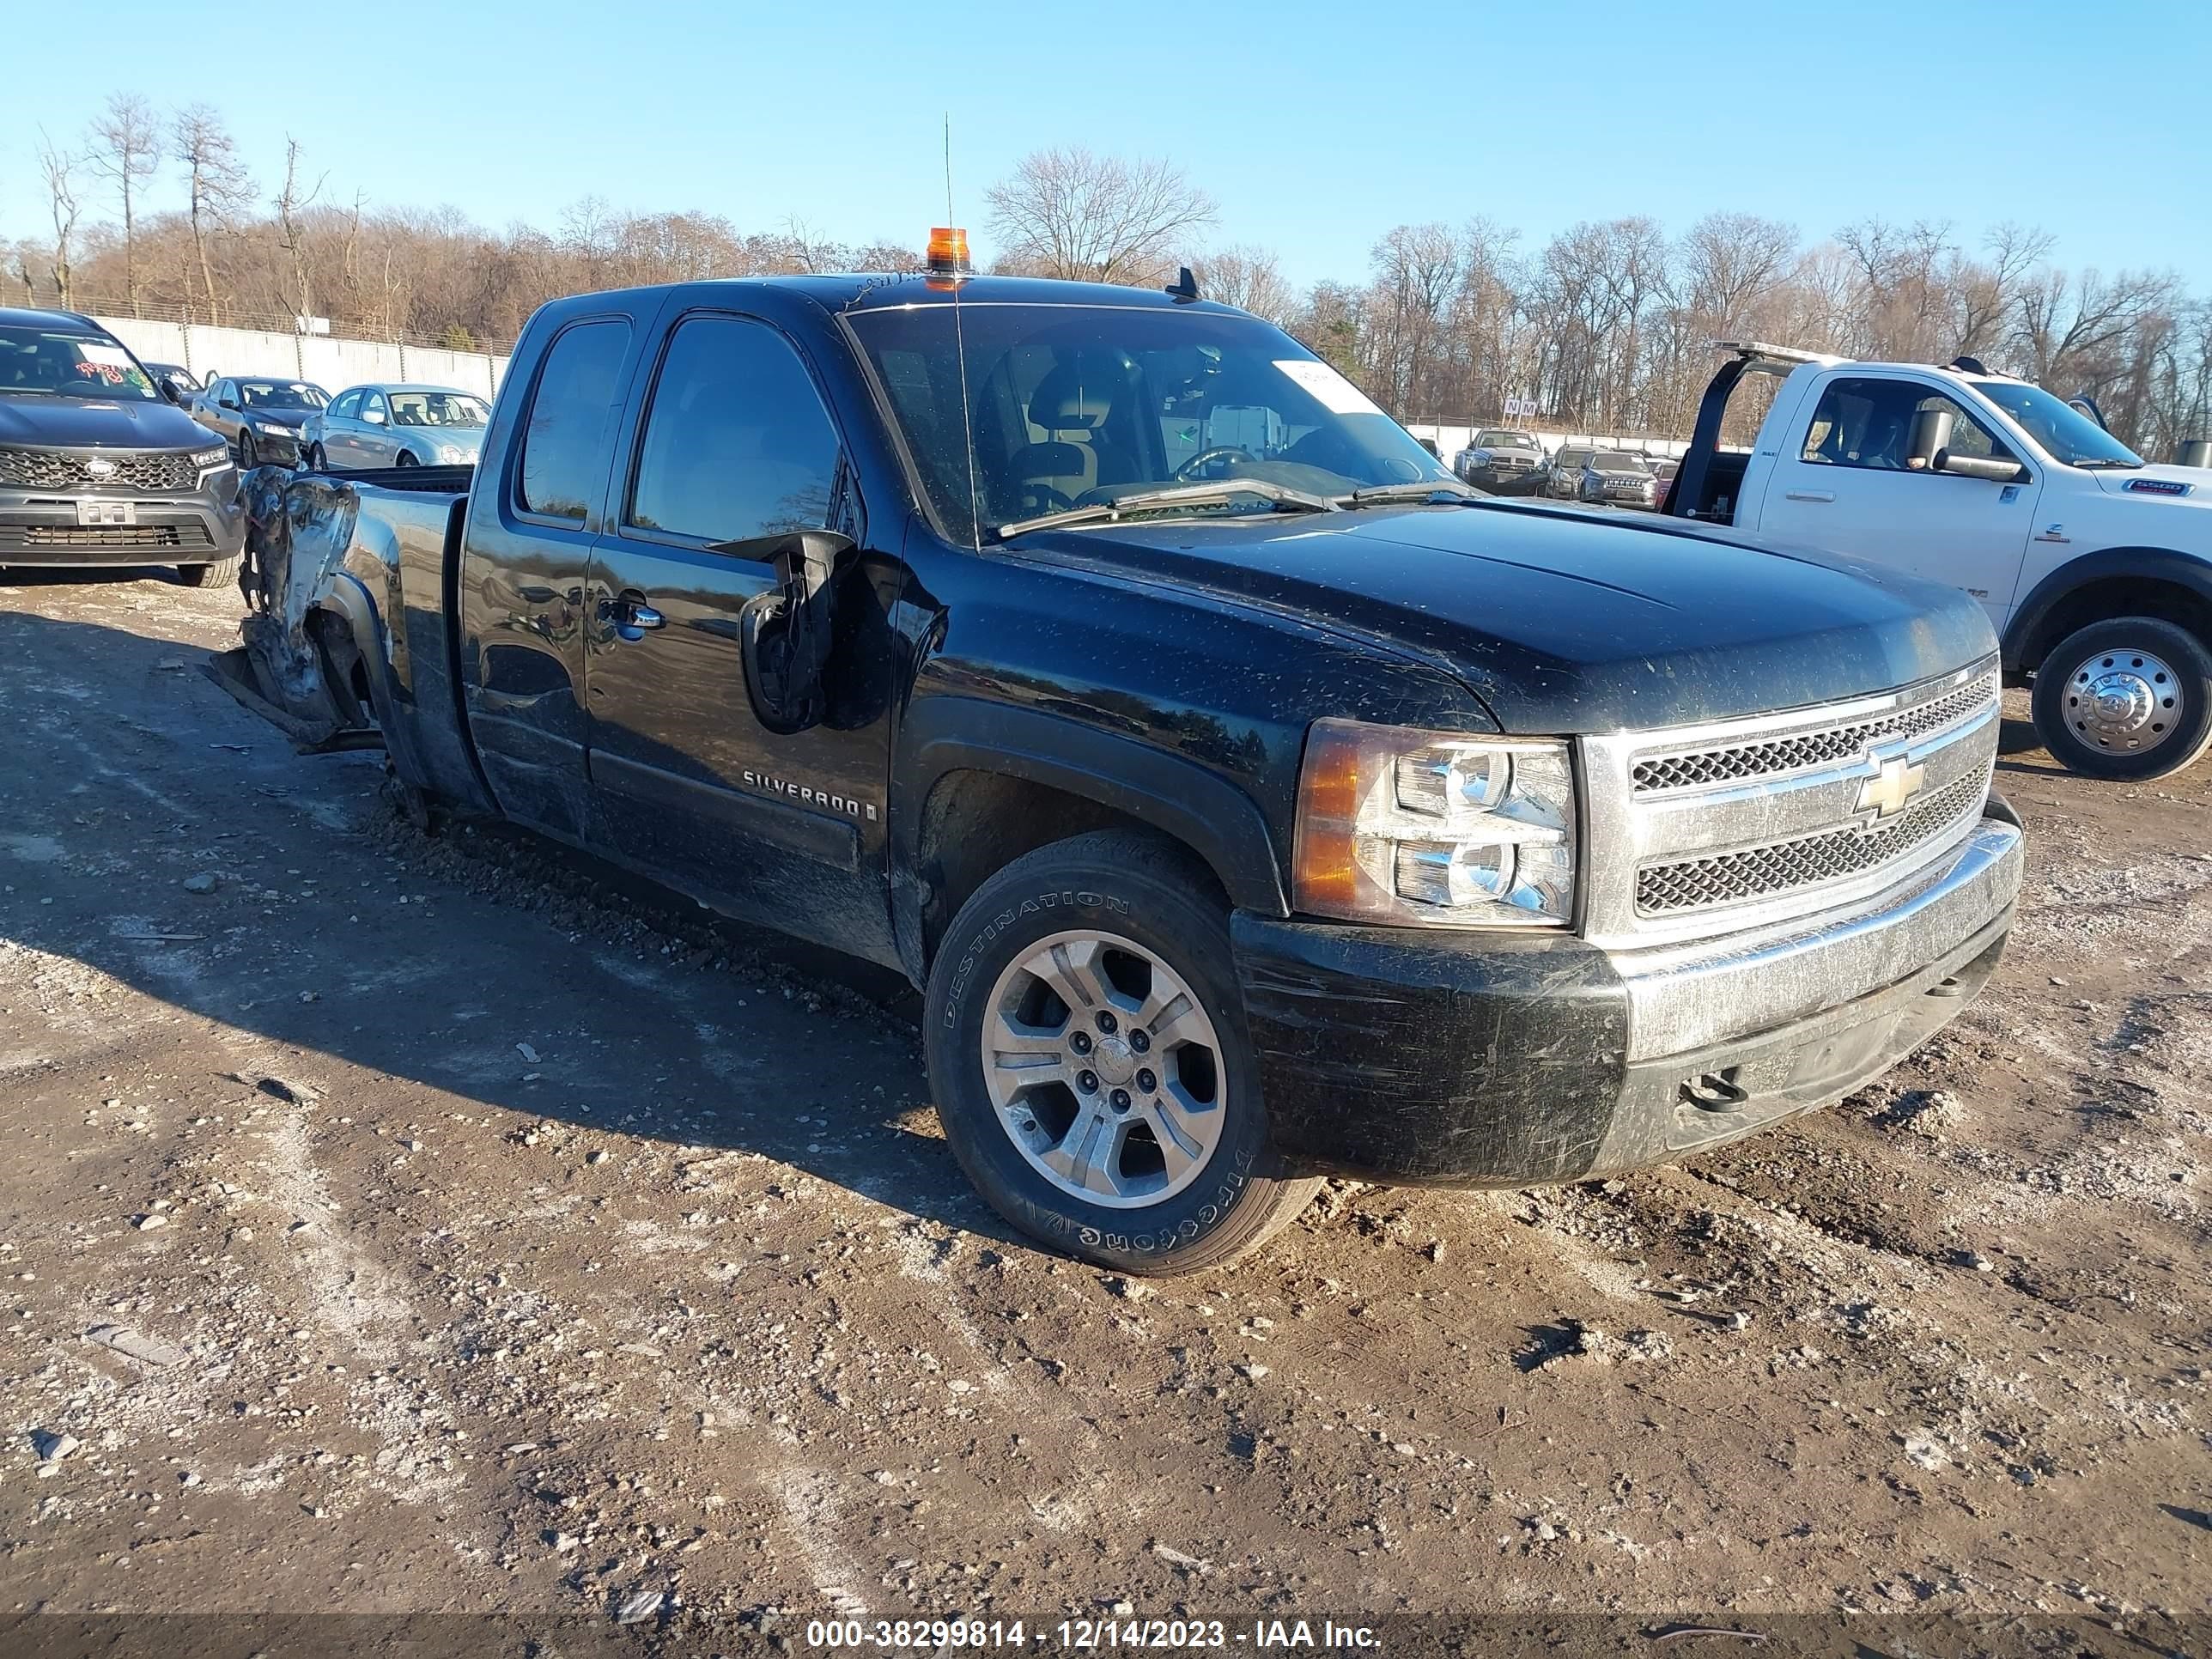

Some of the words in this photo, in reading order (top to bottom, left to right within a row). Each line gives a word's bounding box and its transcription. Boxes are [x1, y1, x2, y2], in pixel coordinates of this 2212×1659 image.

[1508, 401, 1517, 411] N
[1523, 404, 1534, 414] M
[743, 769, 860, 818] SILVERADO
[943, 890, 1129, 1030] DESTINATION
